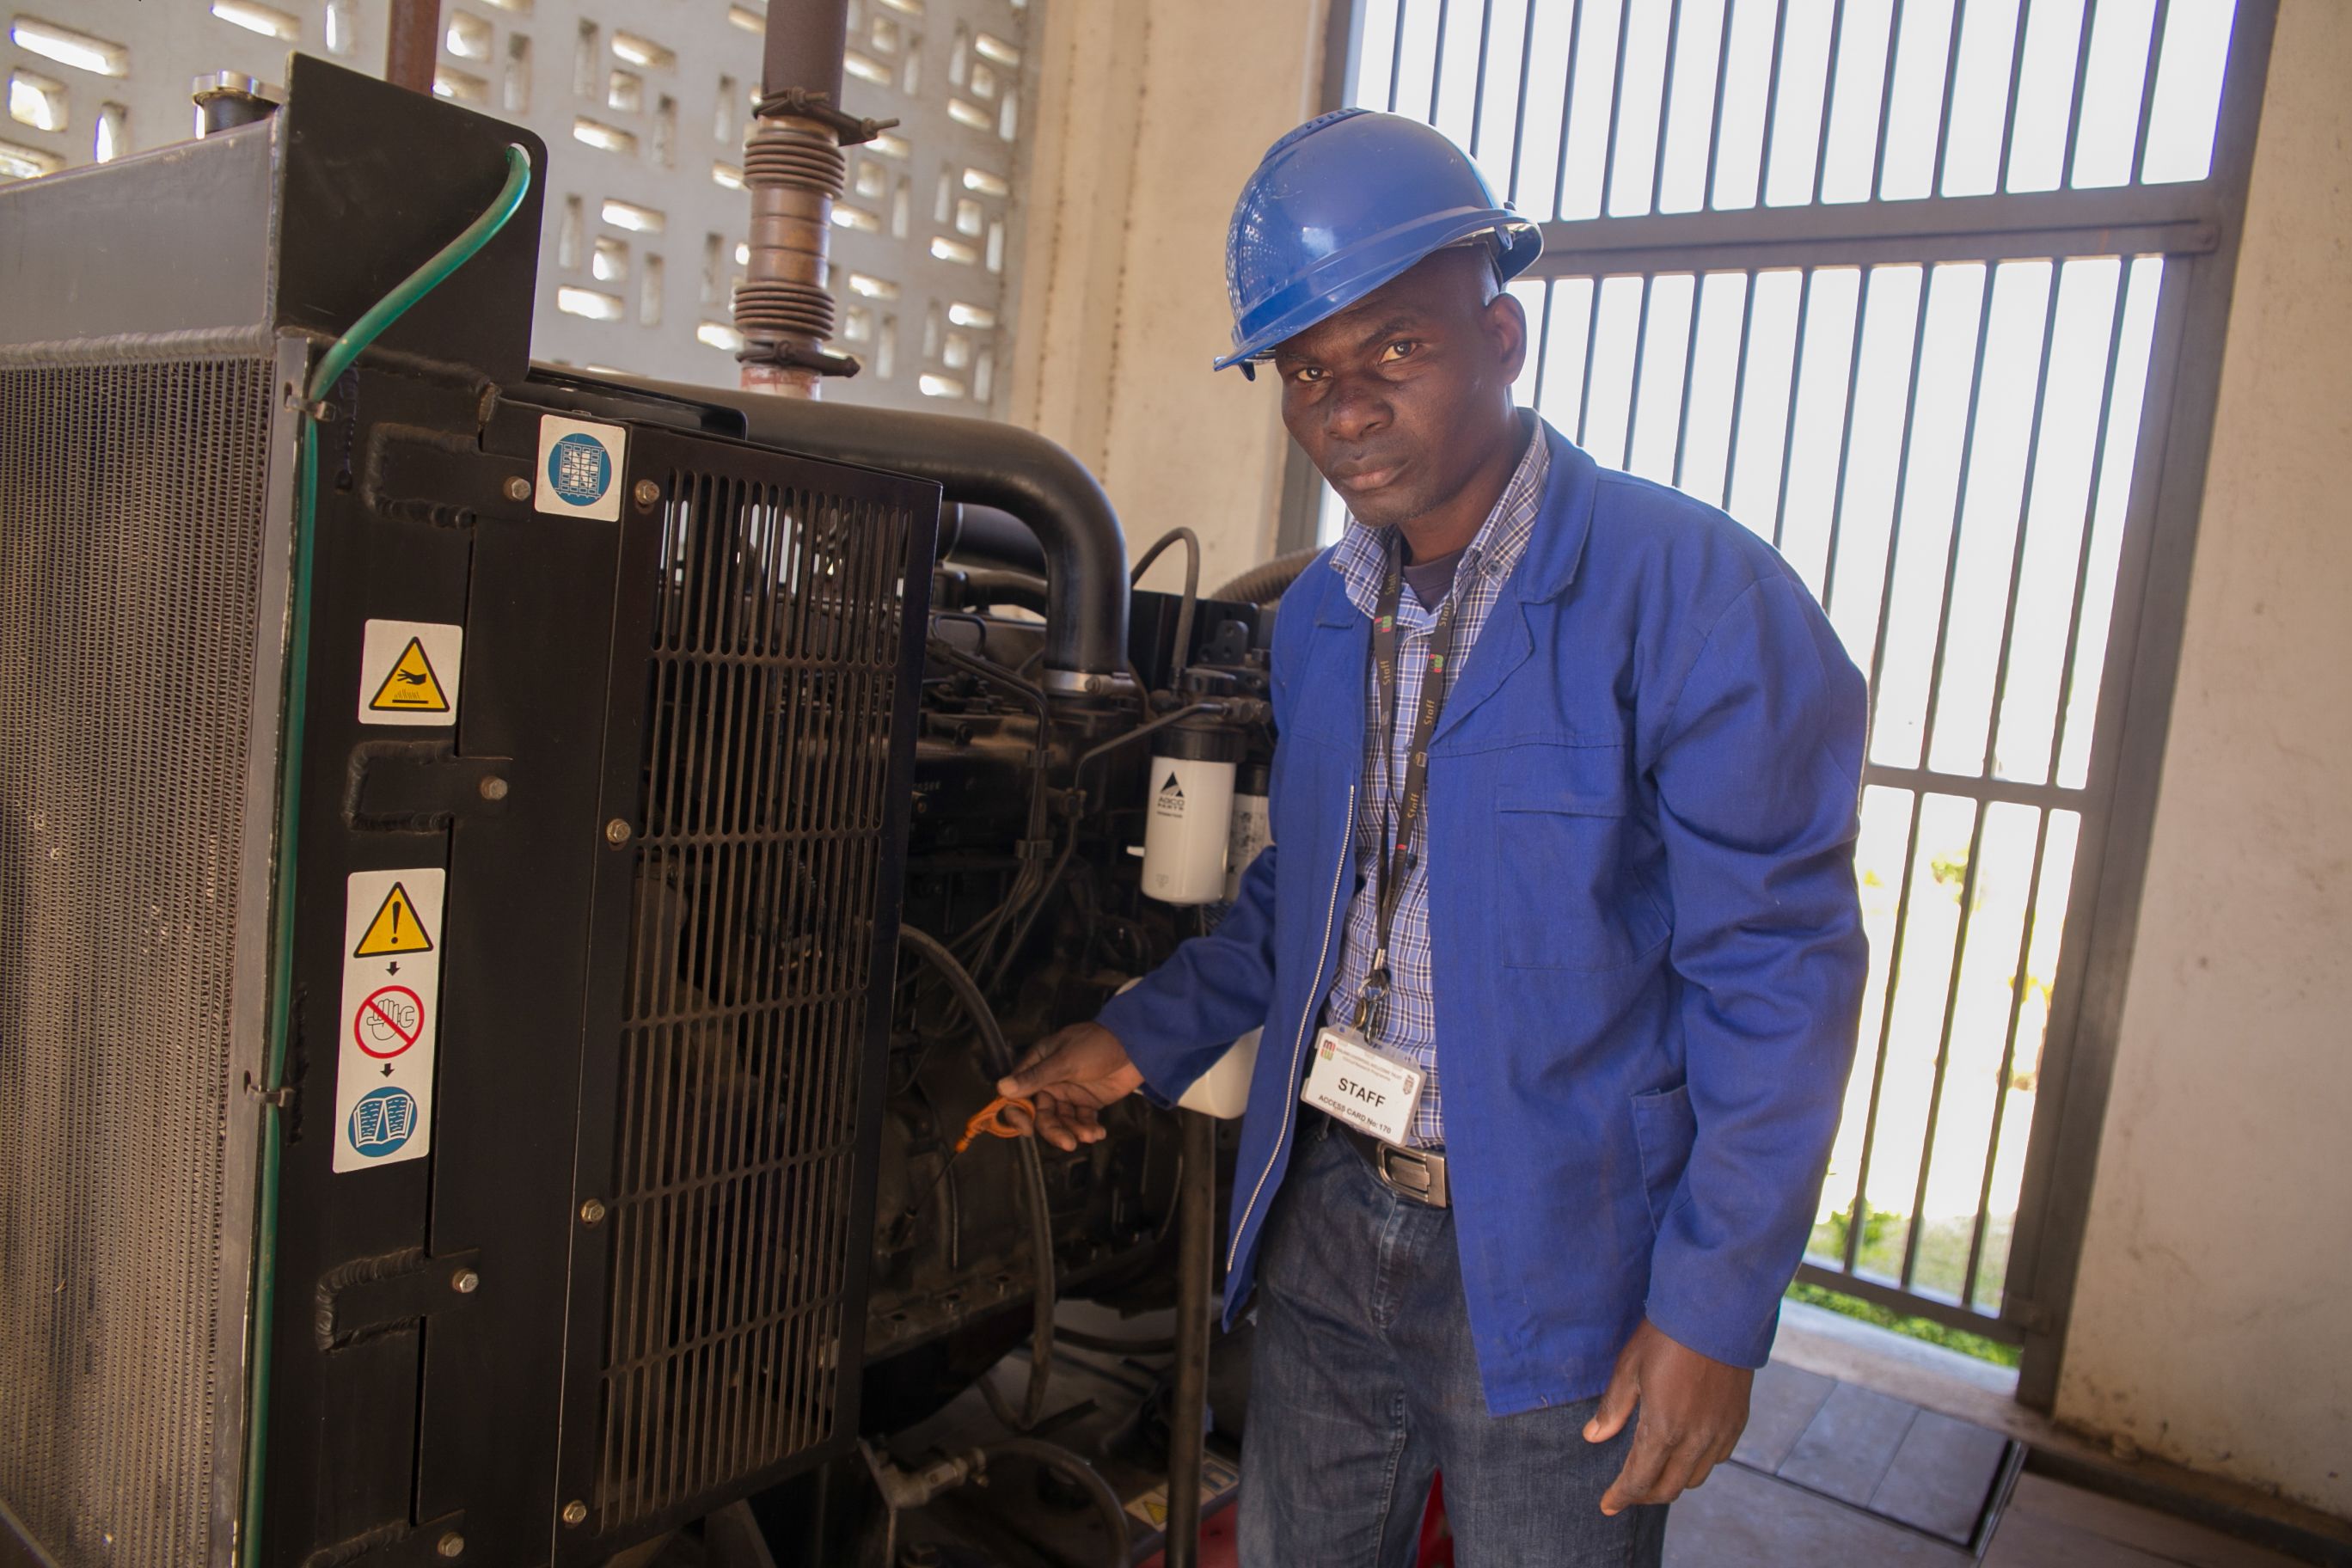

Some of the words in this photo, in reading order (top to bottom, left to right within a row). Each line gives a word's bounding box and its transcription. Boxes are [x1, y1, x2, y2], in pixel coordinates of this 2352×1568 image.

[1385, 573, 1397, 596] Staff
[1438, 602, 1451, 627] Staff
[1379, 659, 1391, 686] Staff
[1424, 699, 1436, 726] Staff
[1407, 793, 1420, 818] Staff
[1338, 1077, 1387, 1107] STAFF
[1319, 1094, 1346, 1112] ACCESS
[1346, 1107, 1366, 1122] CARD
[1379, 1124, 1392, 1134] 170
